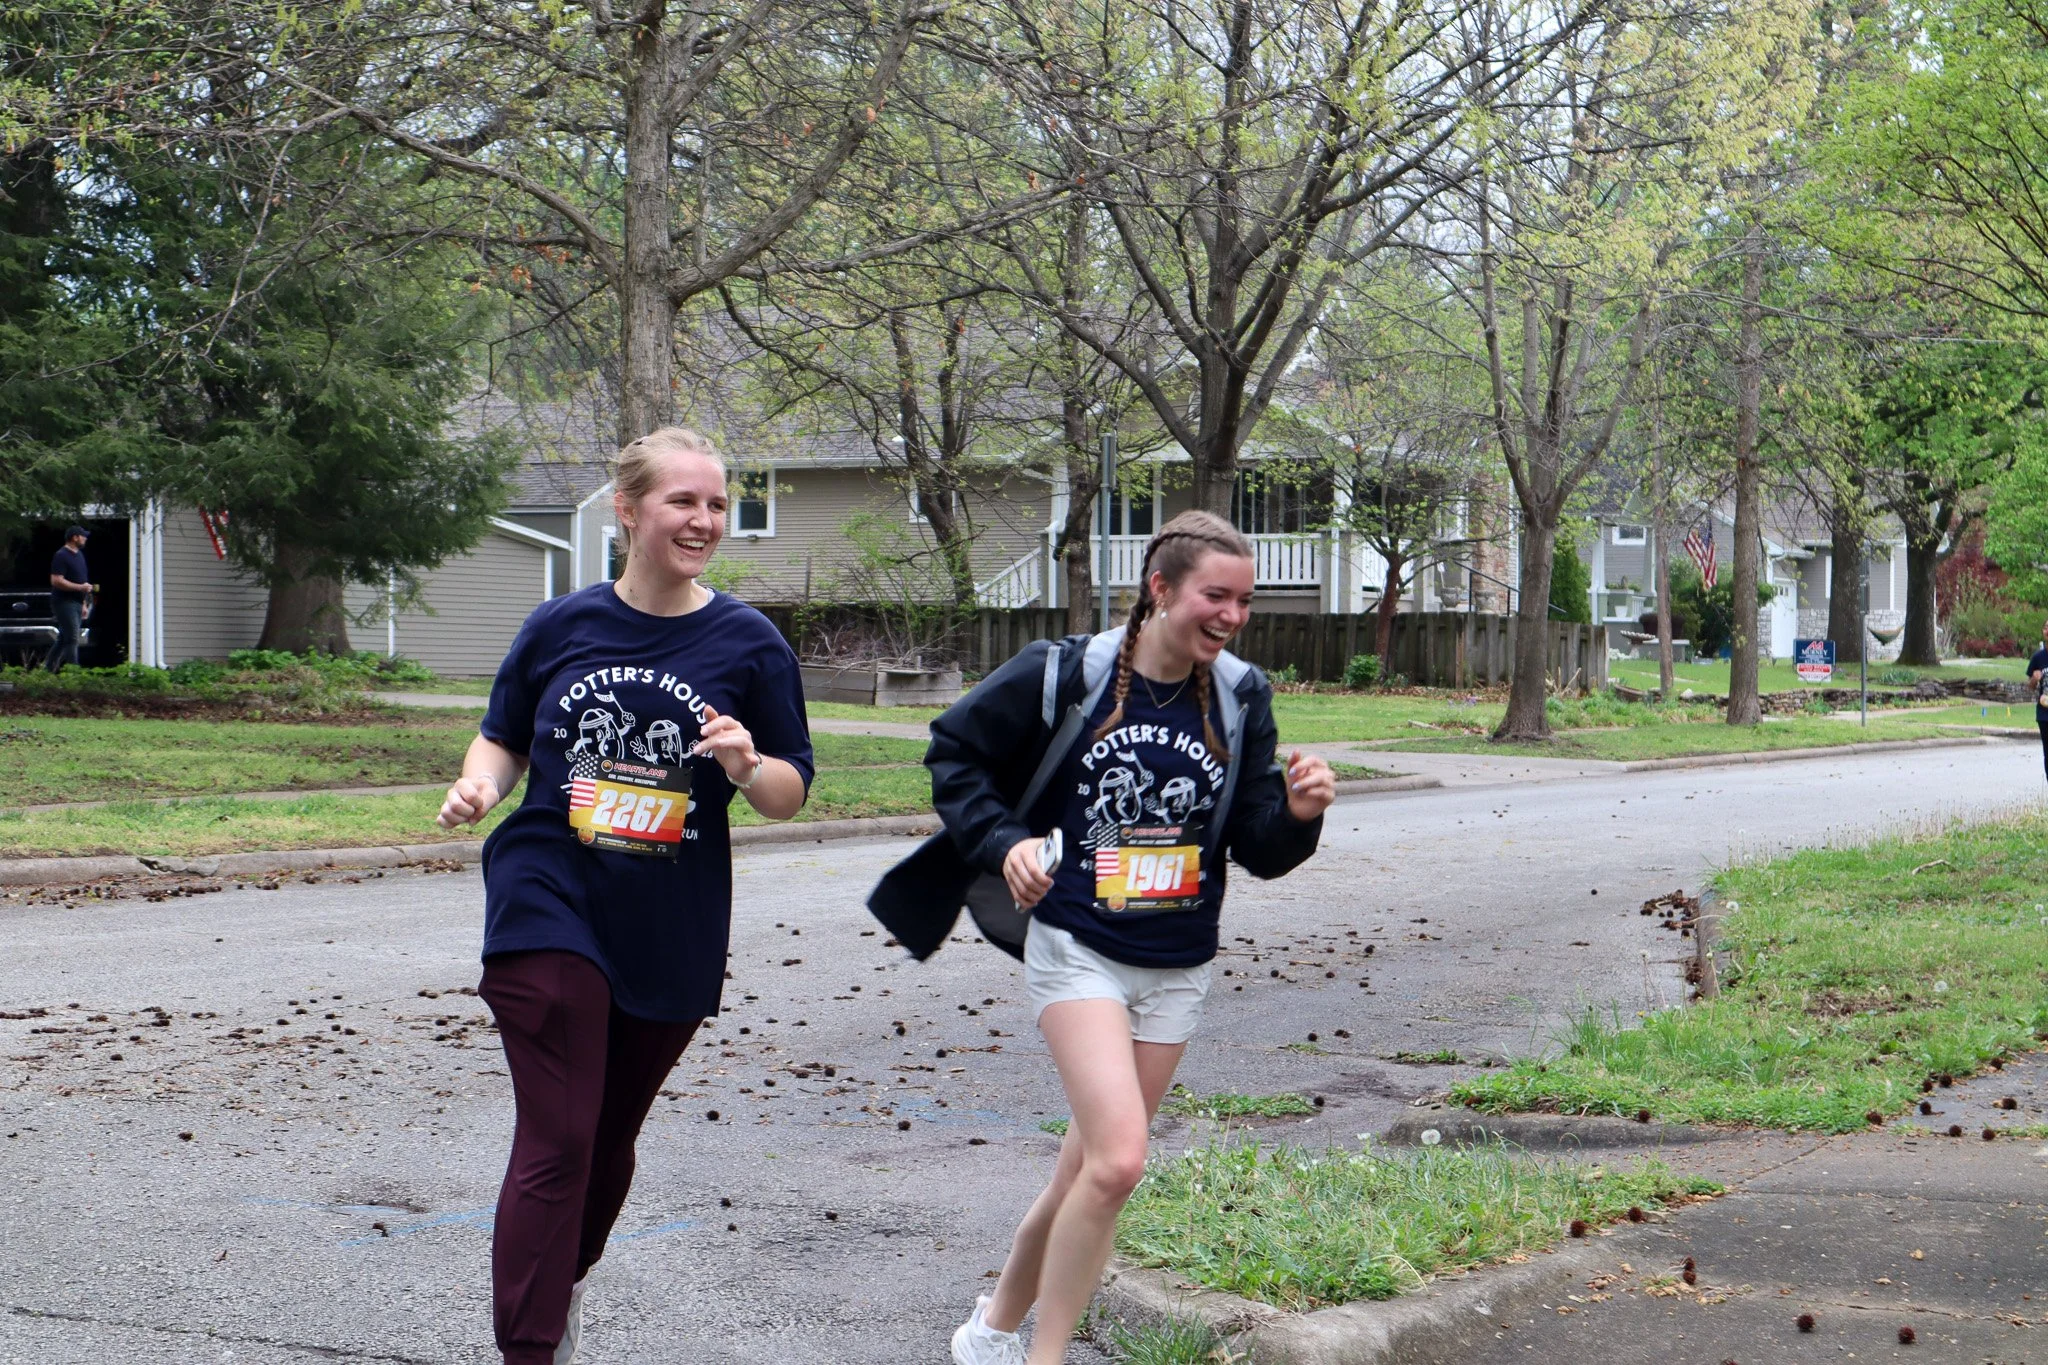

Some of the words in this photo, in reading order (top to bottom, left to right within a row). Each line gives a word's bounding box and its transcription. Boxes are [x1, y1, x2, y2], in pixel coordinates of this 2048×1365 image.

[559, 666, 654, 712] POTTER'S
[658, 672, 707, 724] HOUS
[553, 727, 568, 739] 20
[1081, 724, 1169, 771] POTTER'S
[613, 762, 668, 777] HEARTLAND
[1076, 782, 1091, 796] 20
[590, 788, 674, 834] 2267
[1125, 853, 1185, 892] 1961
